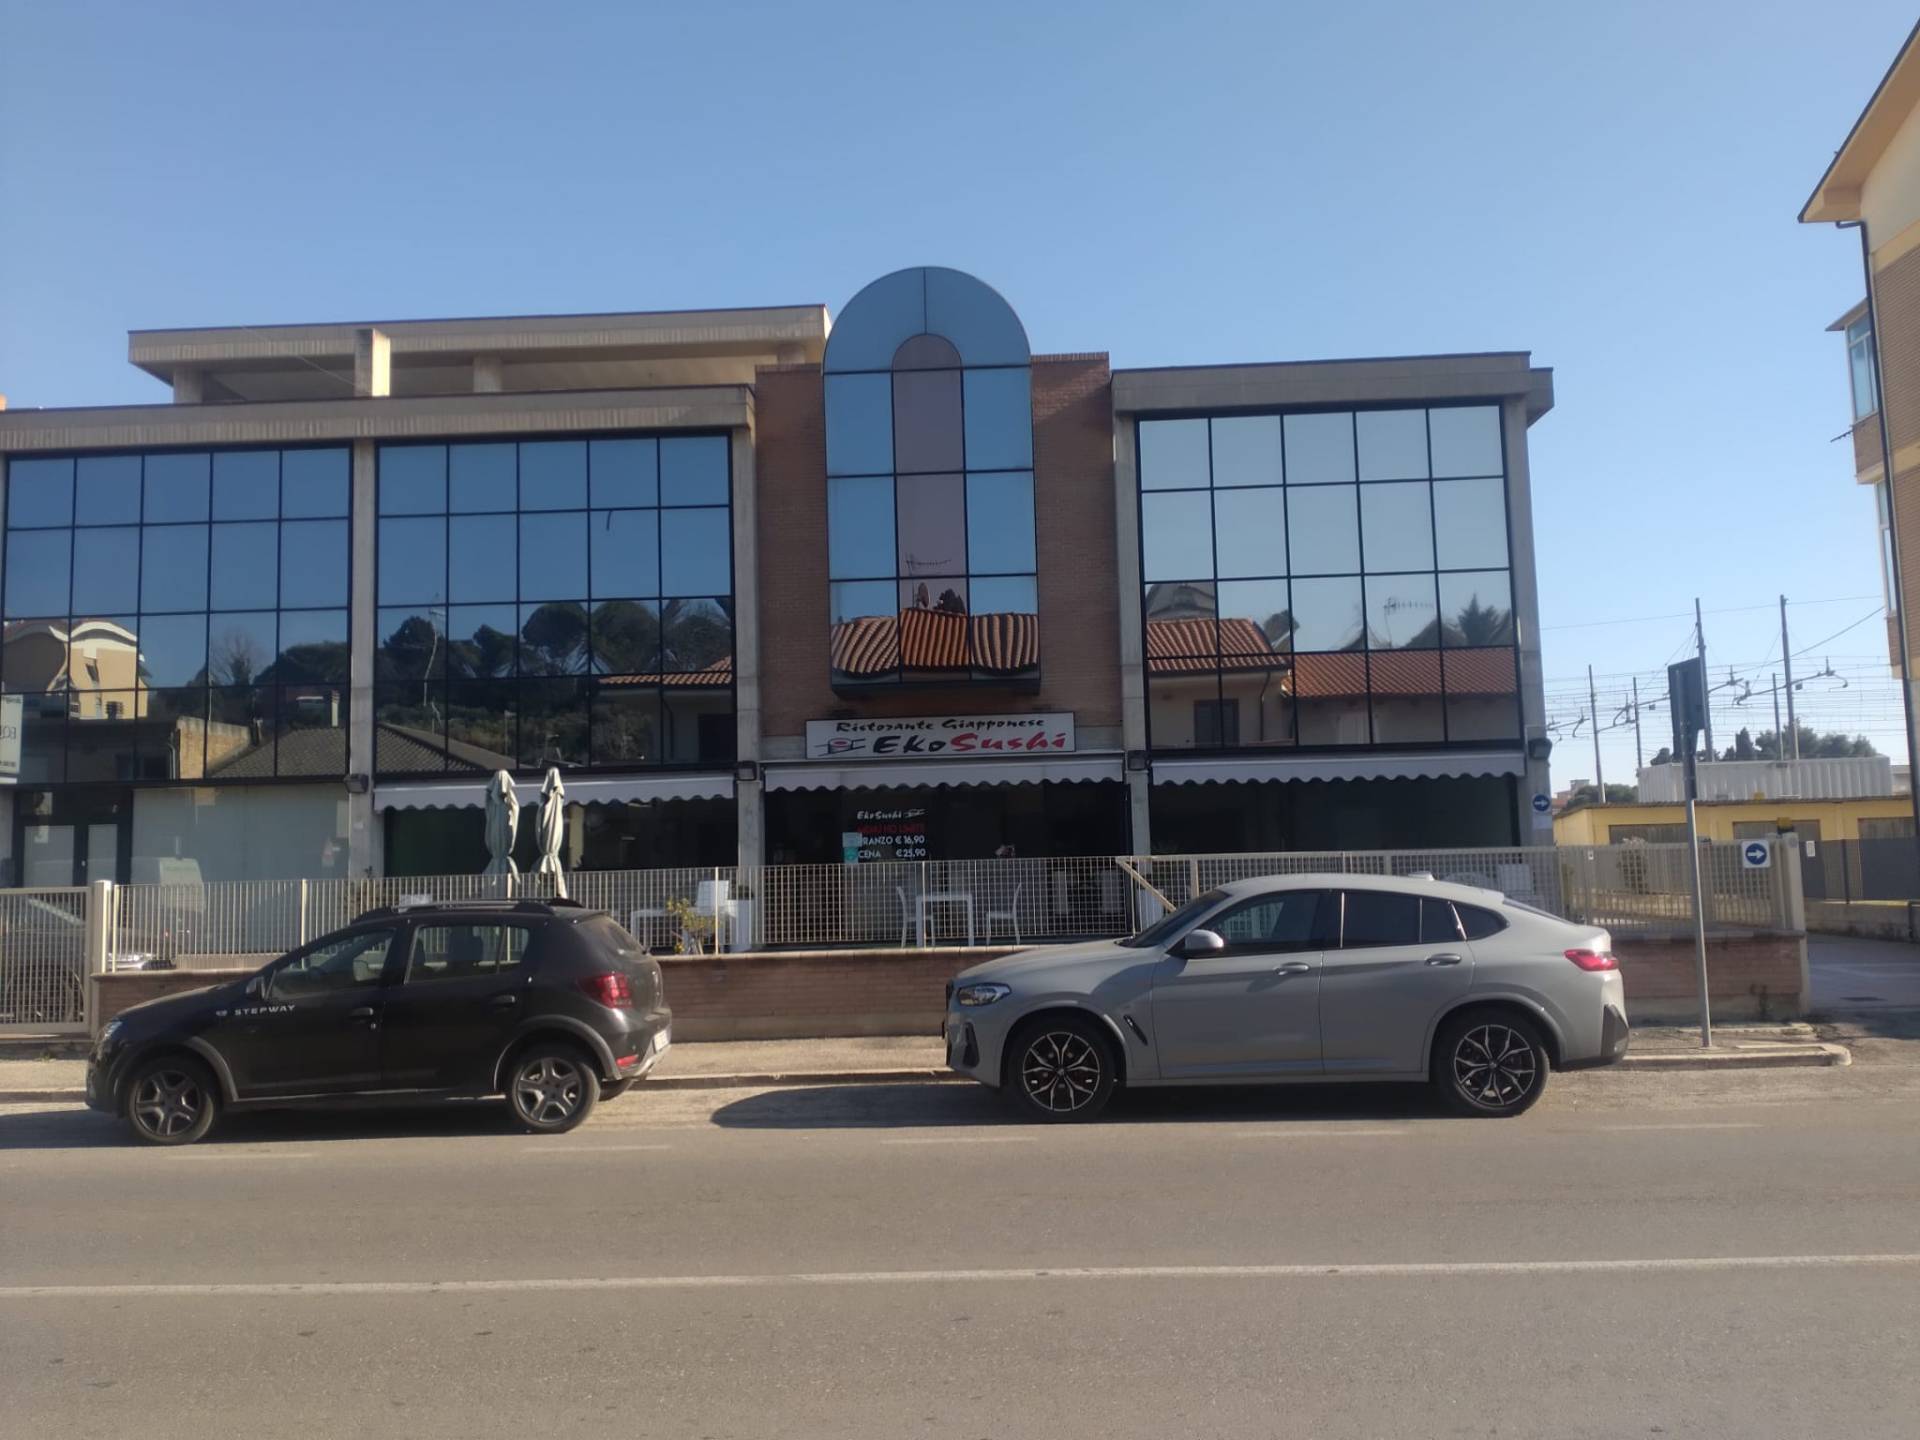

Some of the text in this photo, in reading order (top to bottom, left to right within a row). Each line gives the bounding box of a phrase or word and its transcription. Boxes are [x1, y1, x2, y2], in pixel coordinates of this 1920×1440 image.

[835, 718, 1045, 733] Ristorante Giapponese
[858, 835, 893, 846] RANZO
[858, 850, 881, 859] CENA
[234, 1004, 295, 1016] STEPWAY
